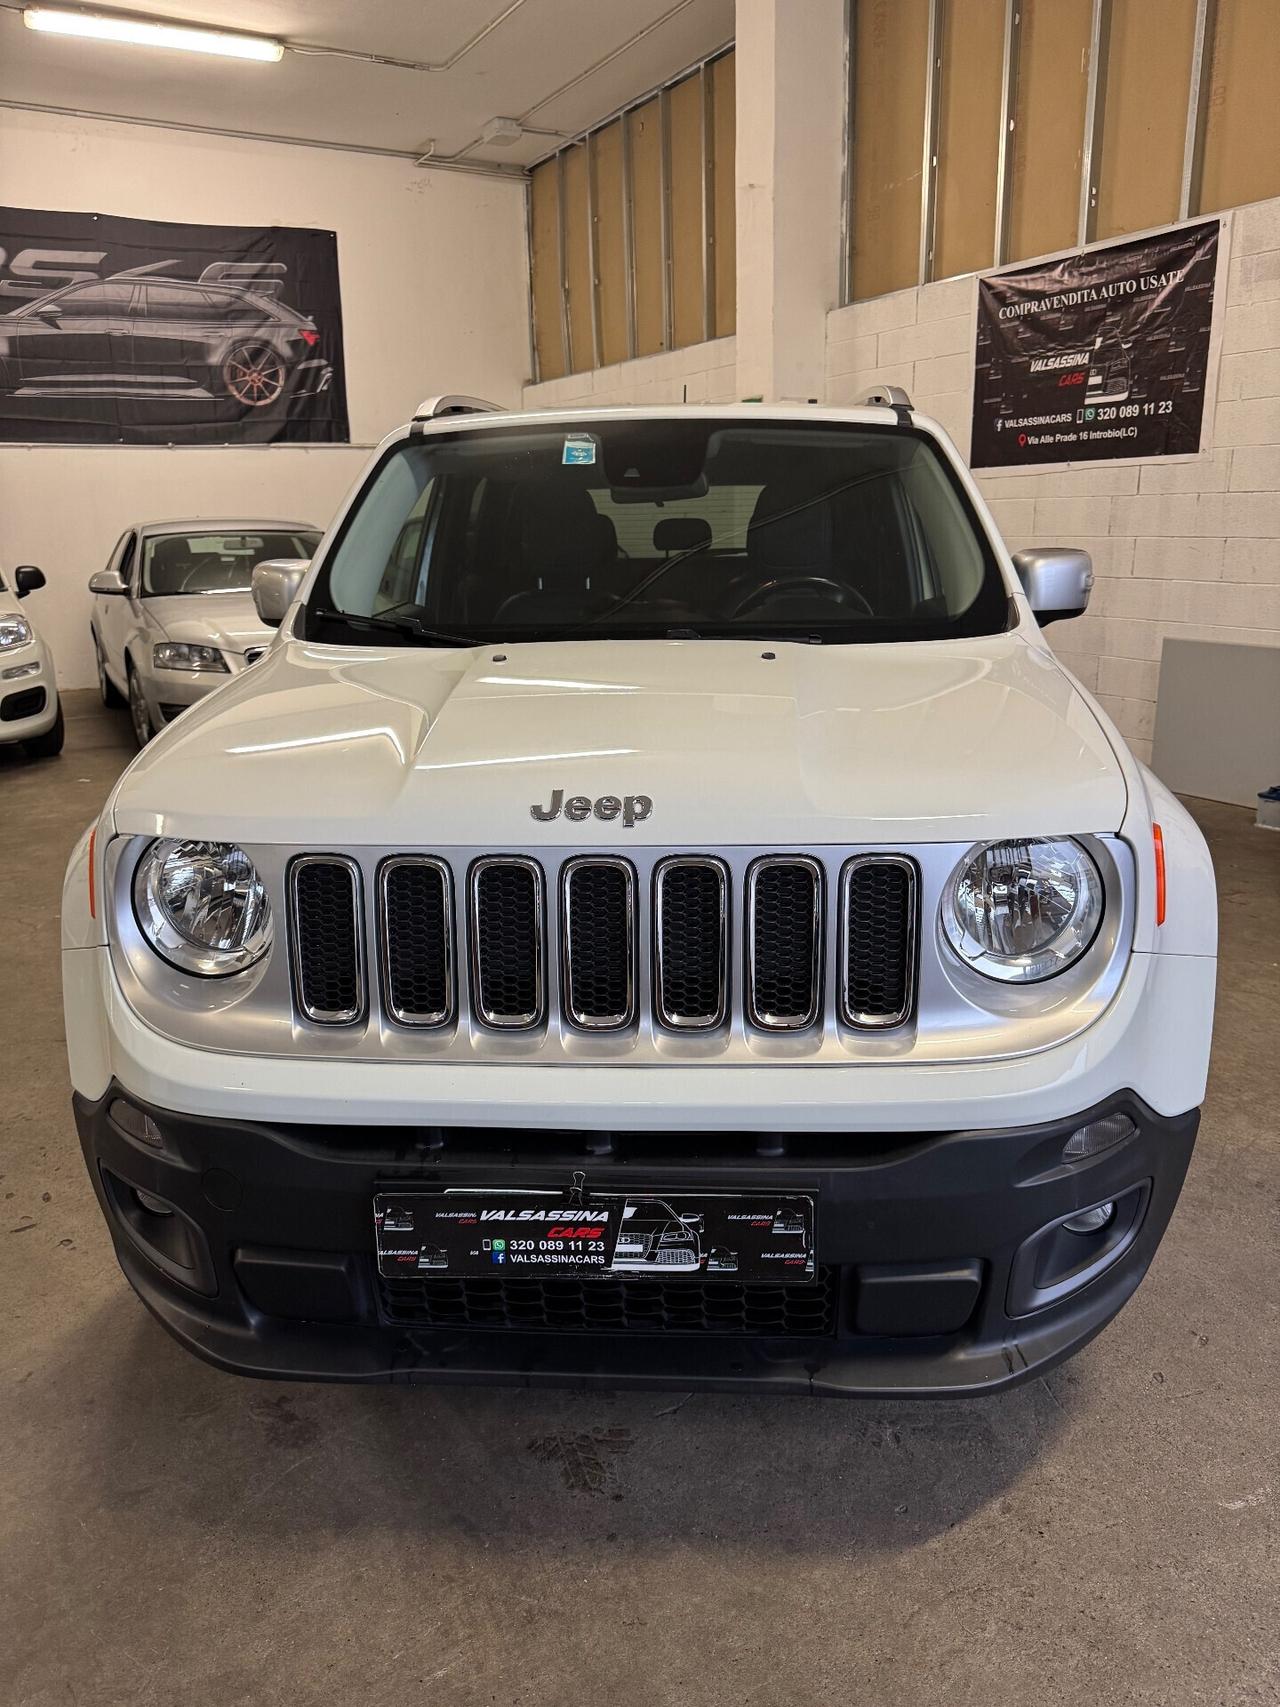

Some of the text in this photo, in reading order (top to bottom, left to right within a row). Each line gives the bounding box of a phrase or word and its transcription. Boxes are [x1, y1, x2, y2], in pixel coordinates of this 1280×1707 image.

[998, 288, 1098, 320] COMPRAVENDITA
[1099, 280, 1137, 299] AUTO
[1140, 269, 1185, 291] USATE
[1030, 352, 1090, 373] VALSASSINA
[1057, 372, 1086, 387] CARS
[1004, 400, 1173, 429] VALSASSINACARS 320 089 11 23
[1027, 427, 1138, 445] Via Alle Prade 16 Introbio(LC)
[529, 788, 655, 829] Jeep
[480, 1210, 609, 1222] VALSASSINA
[546, 1226, 605, 1239] CARS
[509, 1240, 605, 1251] 320 089 11 23
[510, 1254, 605, 1264] VALSASSINACARS
